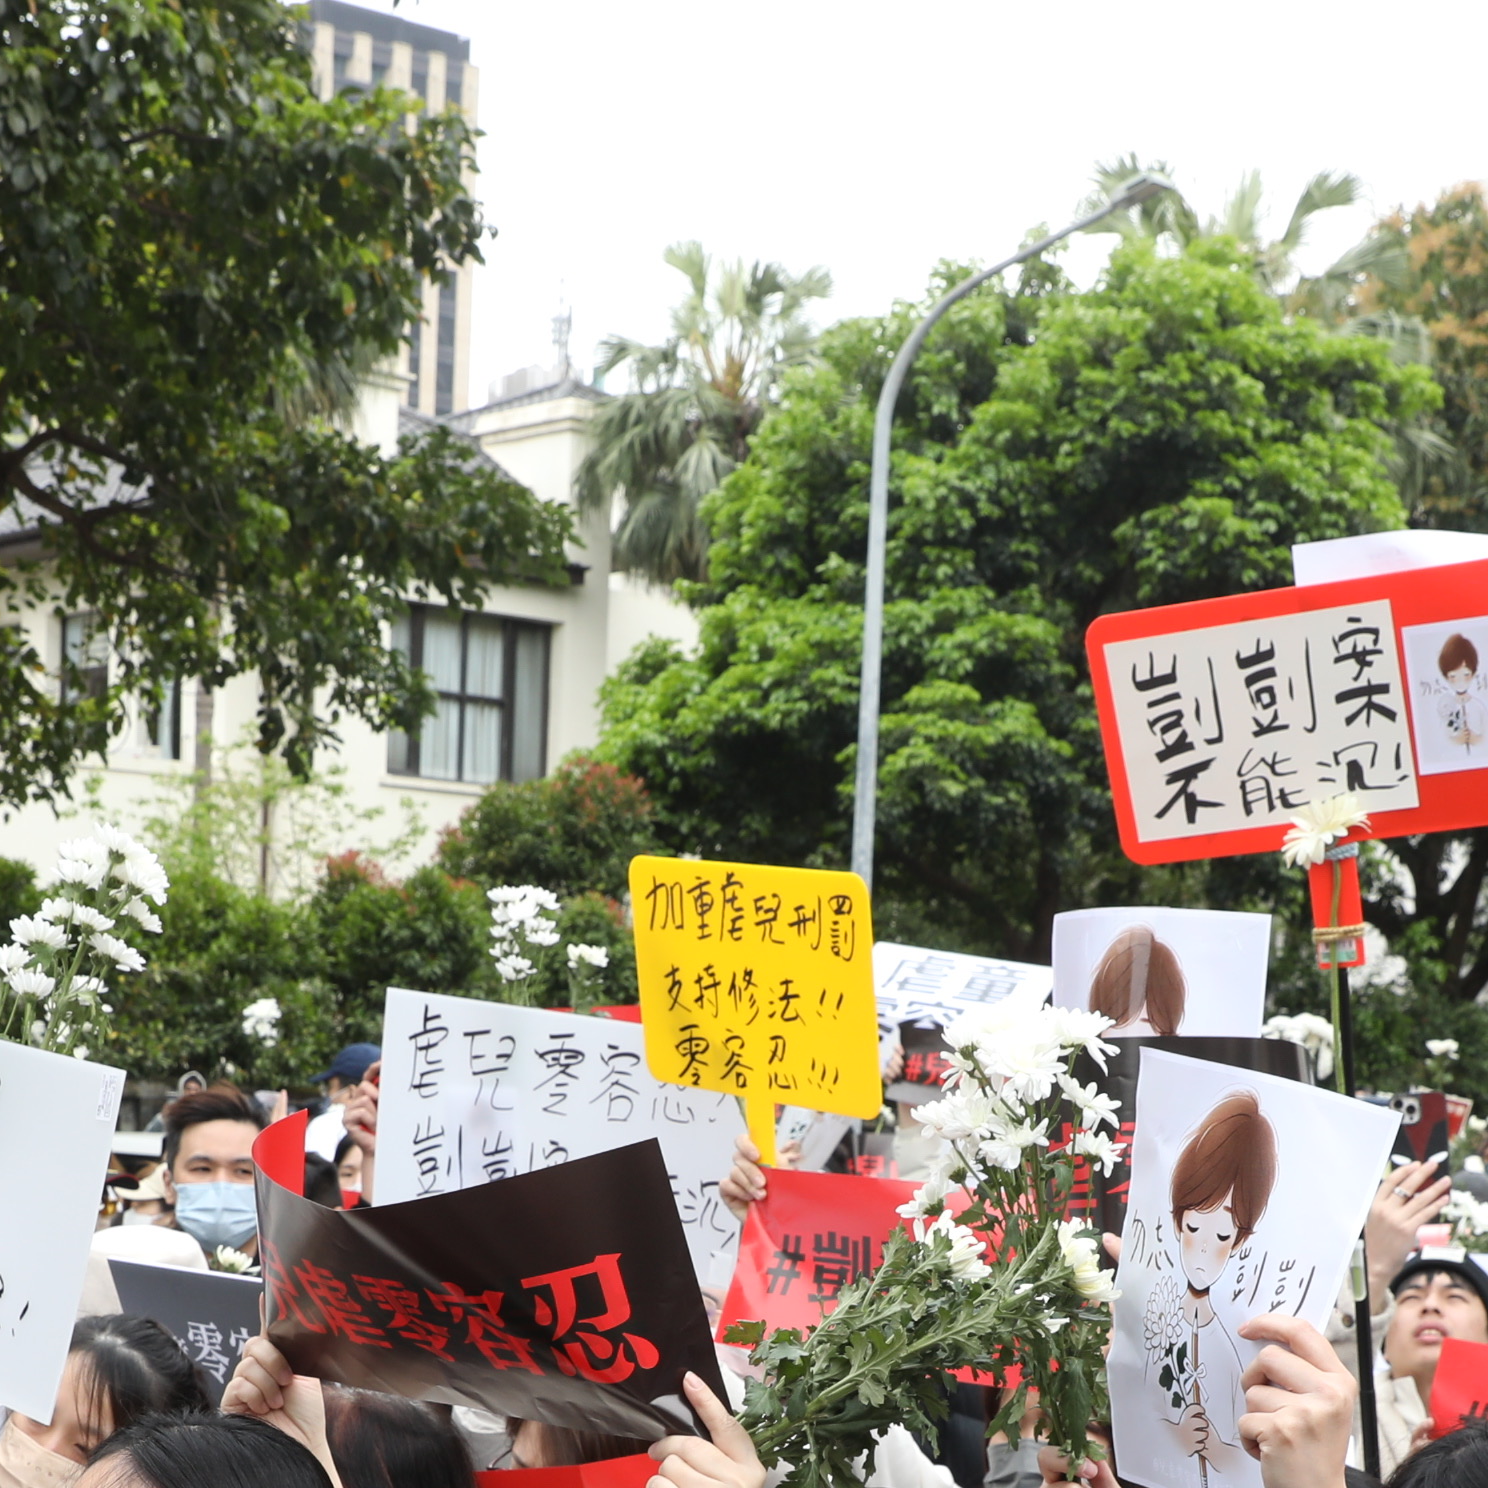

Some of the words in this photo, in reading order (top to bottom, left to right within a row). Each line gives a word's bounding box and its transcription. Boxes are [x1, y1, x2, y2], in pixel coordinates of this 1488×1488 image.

[1132, 616, 1398, 763] 剴剴案
[645, 872, 856, 962] 加重虐兒刑罰
[664, 964, 844, 1026] 支持修法!!
[766, 1231, 890, 1304] #剴
